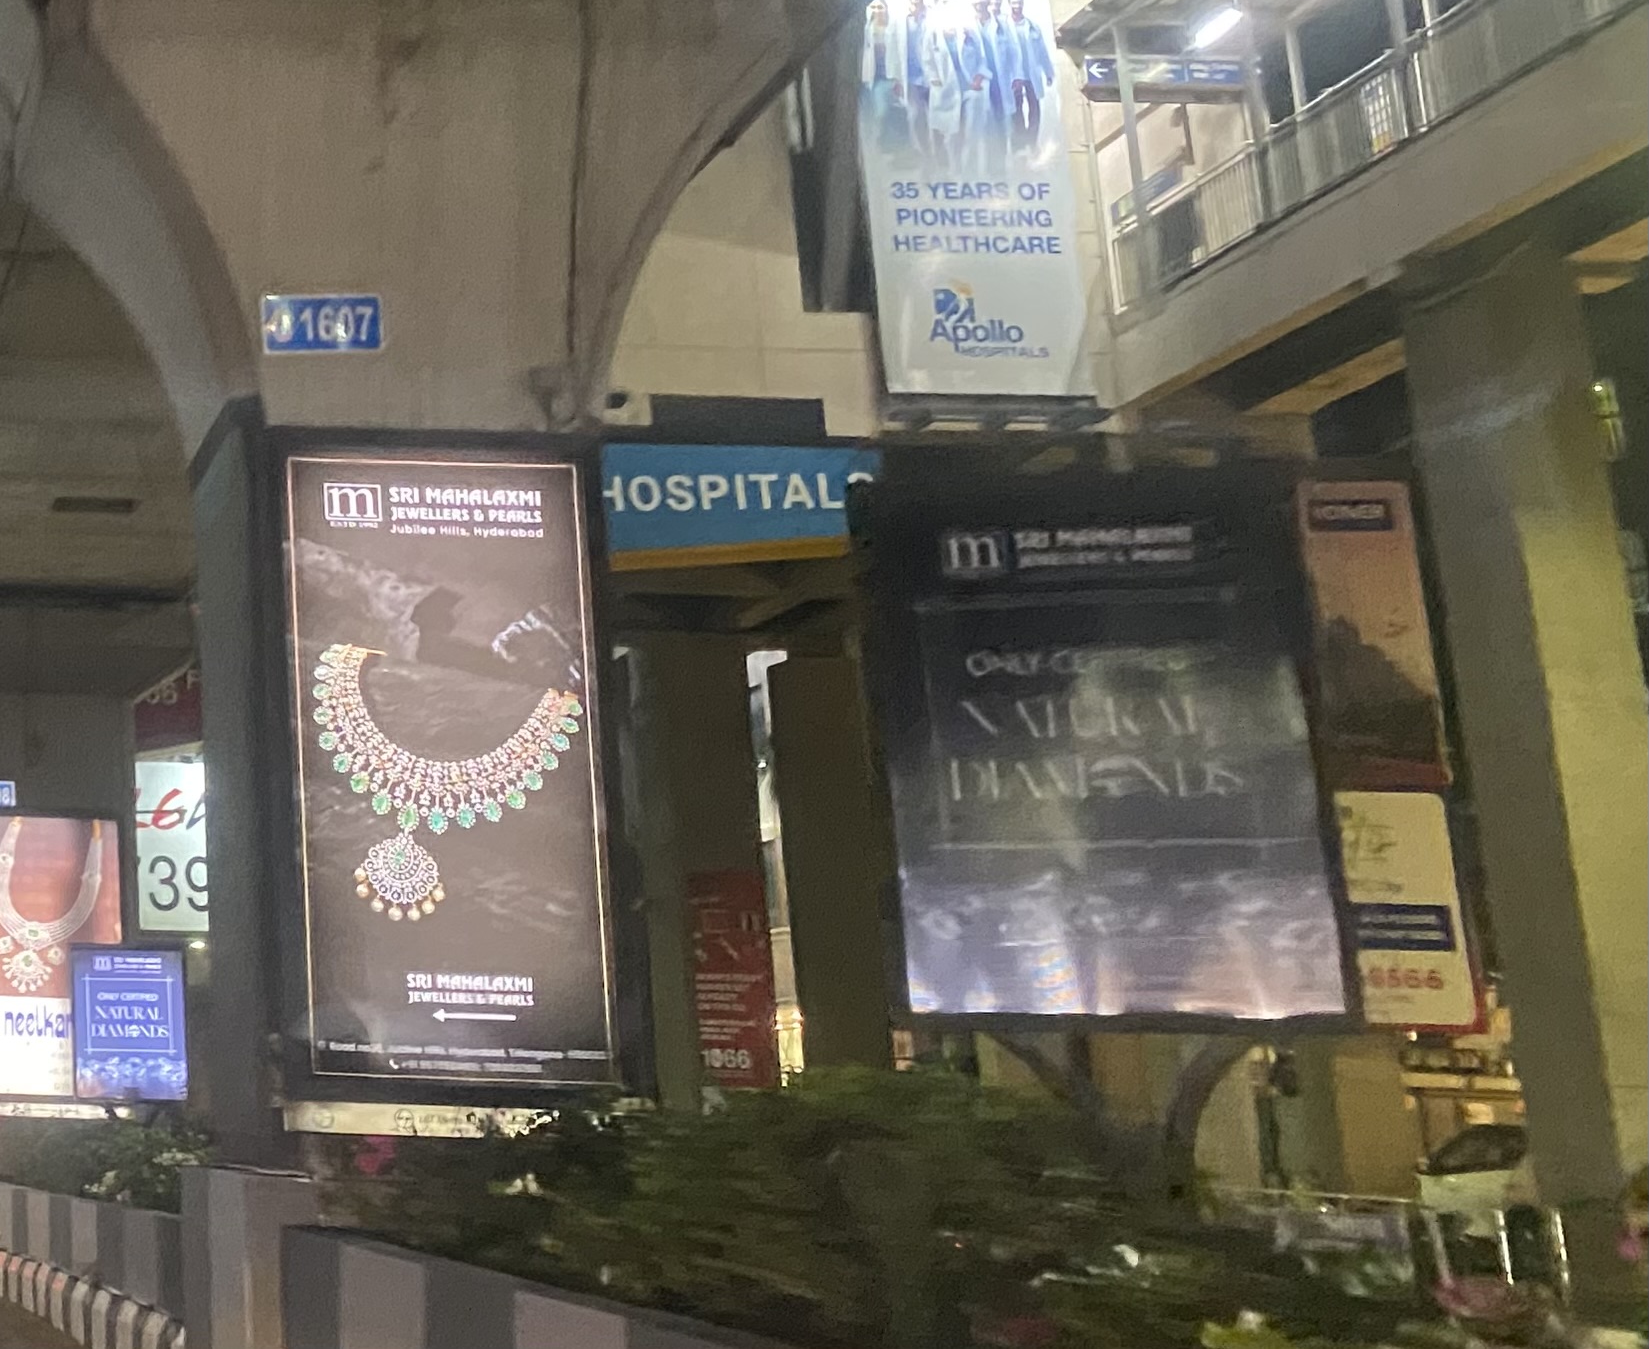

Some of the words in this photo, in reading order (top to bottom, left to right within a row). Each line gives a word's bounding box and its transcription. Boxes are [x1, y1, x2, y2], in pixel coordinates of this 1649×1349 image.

[891, 182, 919, 200] 35
[926, 182, 1008, 201] YEARS
[1018, 183, 1051, 201] OF
[896, 207, 1052, 228] PIONEERING
[893, 234, 1061, 255] HEALTHCARE
[930, 318, 1023, 352] Apollo
[389, 486, 420, 505] SRI
[425, 487, 541, 507] MAHALAXMI
[602, 472, 873, 512] HOSPITAL
[390, 507, 470, 521] JEWELLERS
[474, 508, 484, 521] &
[489, 509, 542, 523] PEARLS
[390, 524, 436, 536] Jubilee
[440, 525, 470, 537] Hills,
[474, 526, 544, 539] Hyderabad
[407, 973, 432, 989] SRI
[436, 974, 533, 992] MAHALAXMI
[408, 991, 472, 1004] JEWELLERS
[489, 994, 535, 1006] PEARLS
[95, 1005, 163, 1020] NATURAL
